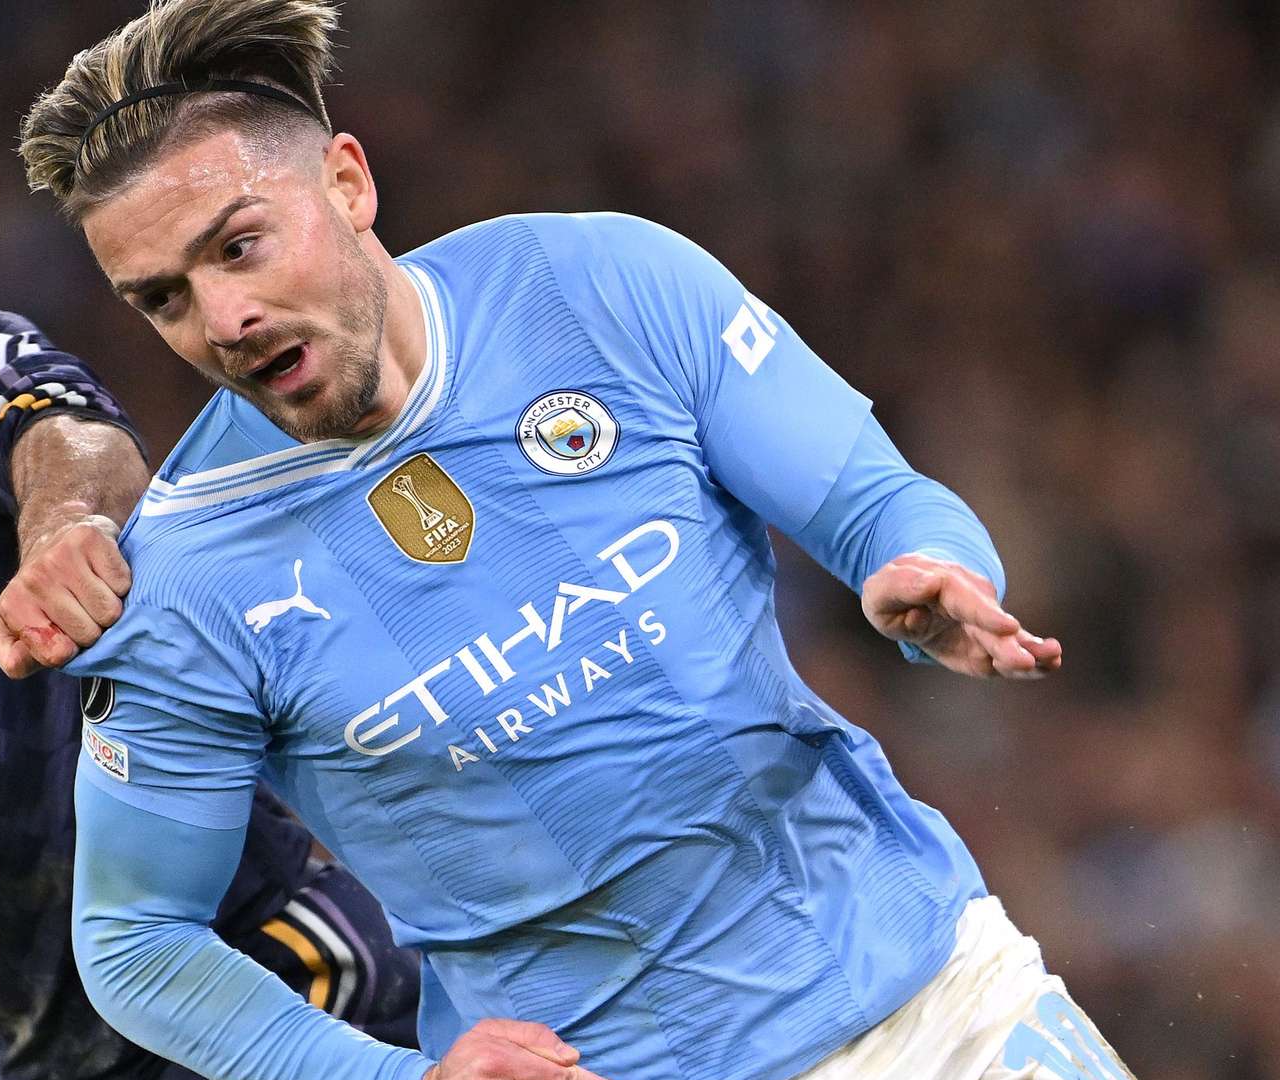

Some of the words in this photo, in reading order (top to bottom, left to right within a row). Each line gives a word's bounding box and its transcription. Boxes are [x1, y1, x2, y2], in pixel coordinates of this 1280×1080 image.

[523, 396, 591, 439] MANCHESTER
[576, 451, 602, 471] CITY
[423, 518, 460, 548] FIFA
[442, 537, 462, 556] 2023
[343, 519, 681, 756] ETIHAD
[446, 609, 669, 772] AIRWAYS
